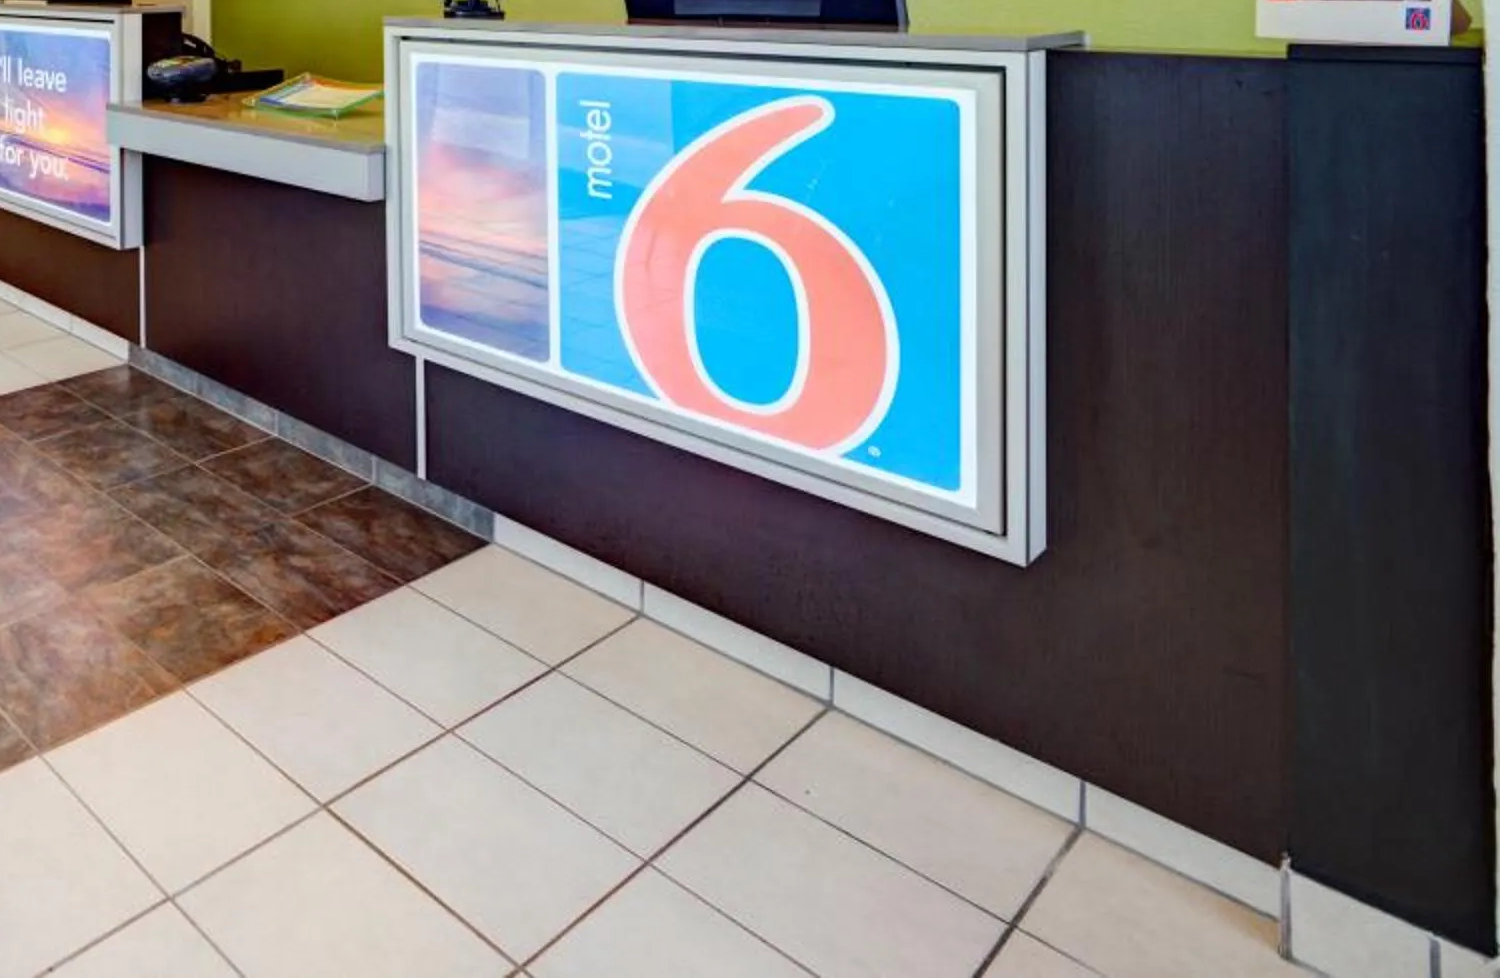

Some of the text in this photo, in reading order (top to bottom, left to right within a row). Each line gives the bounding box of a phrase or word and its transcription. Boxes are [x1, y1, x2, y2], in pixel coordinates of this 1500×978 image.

[18, 58, 67, 92] leave
[4, 97, 44, 133] light
[30, 153, 69, 180] you.
[579, 94, 899, 458] motel 6
